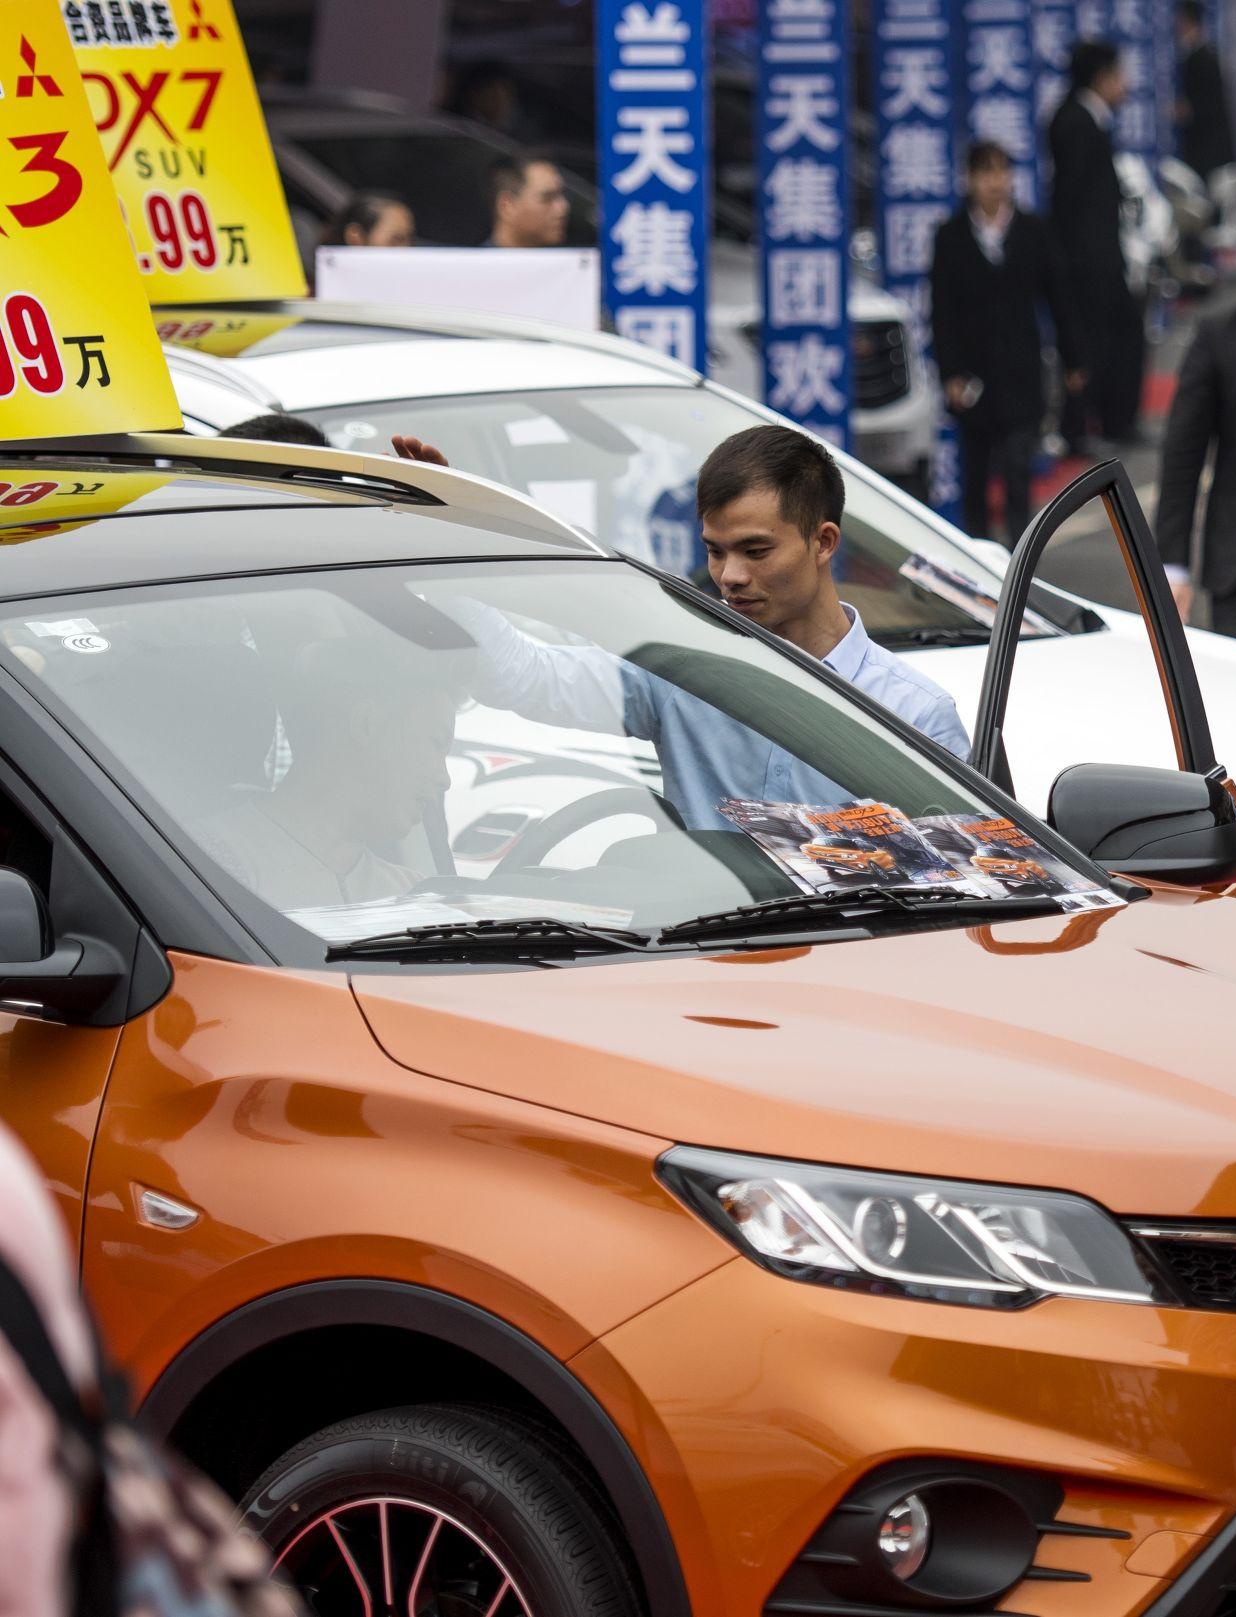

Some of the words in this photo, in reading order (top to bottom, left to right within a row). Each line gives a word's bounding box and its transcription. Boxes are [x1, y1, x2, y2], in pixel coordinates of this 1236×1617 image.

[0, 131, 83, 238] 3
[134, 149, 207, 178] SUV
[609, 2, 698, 376] 兰天集团
